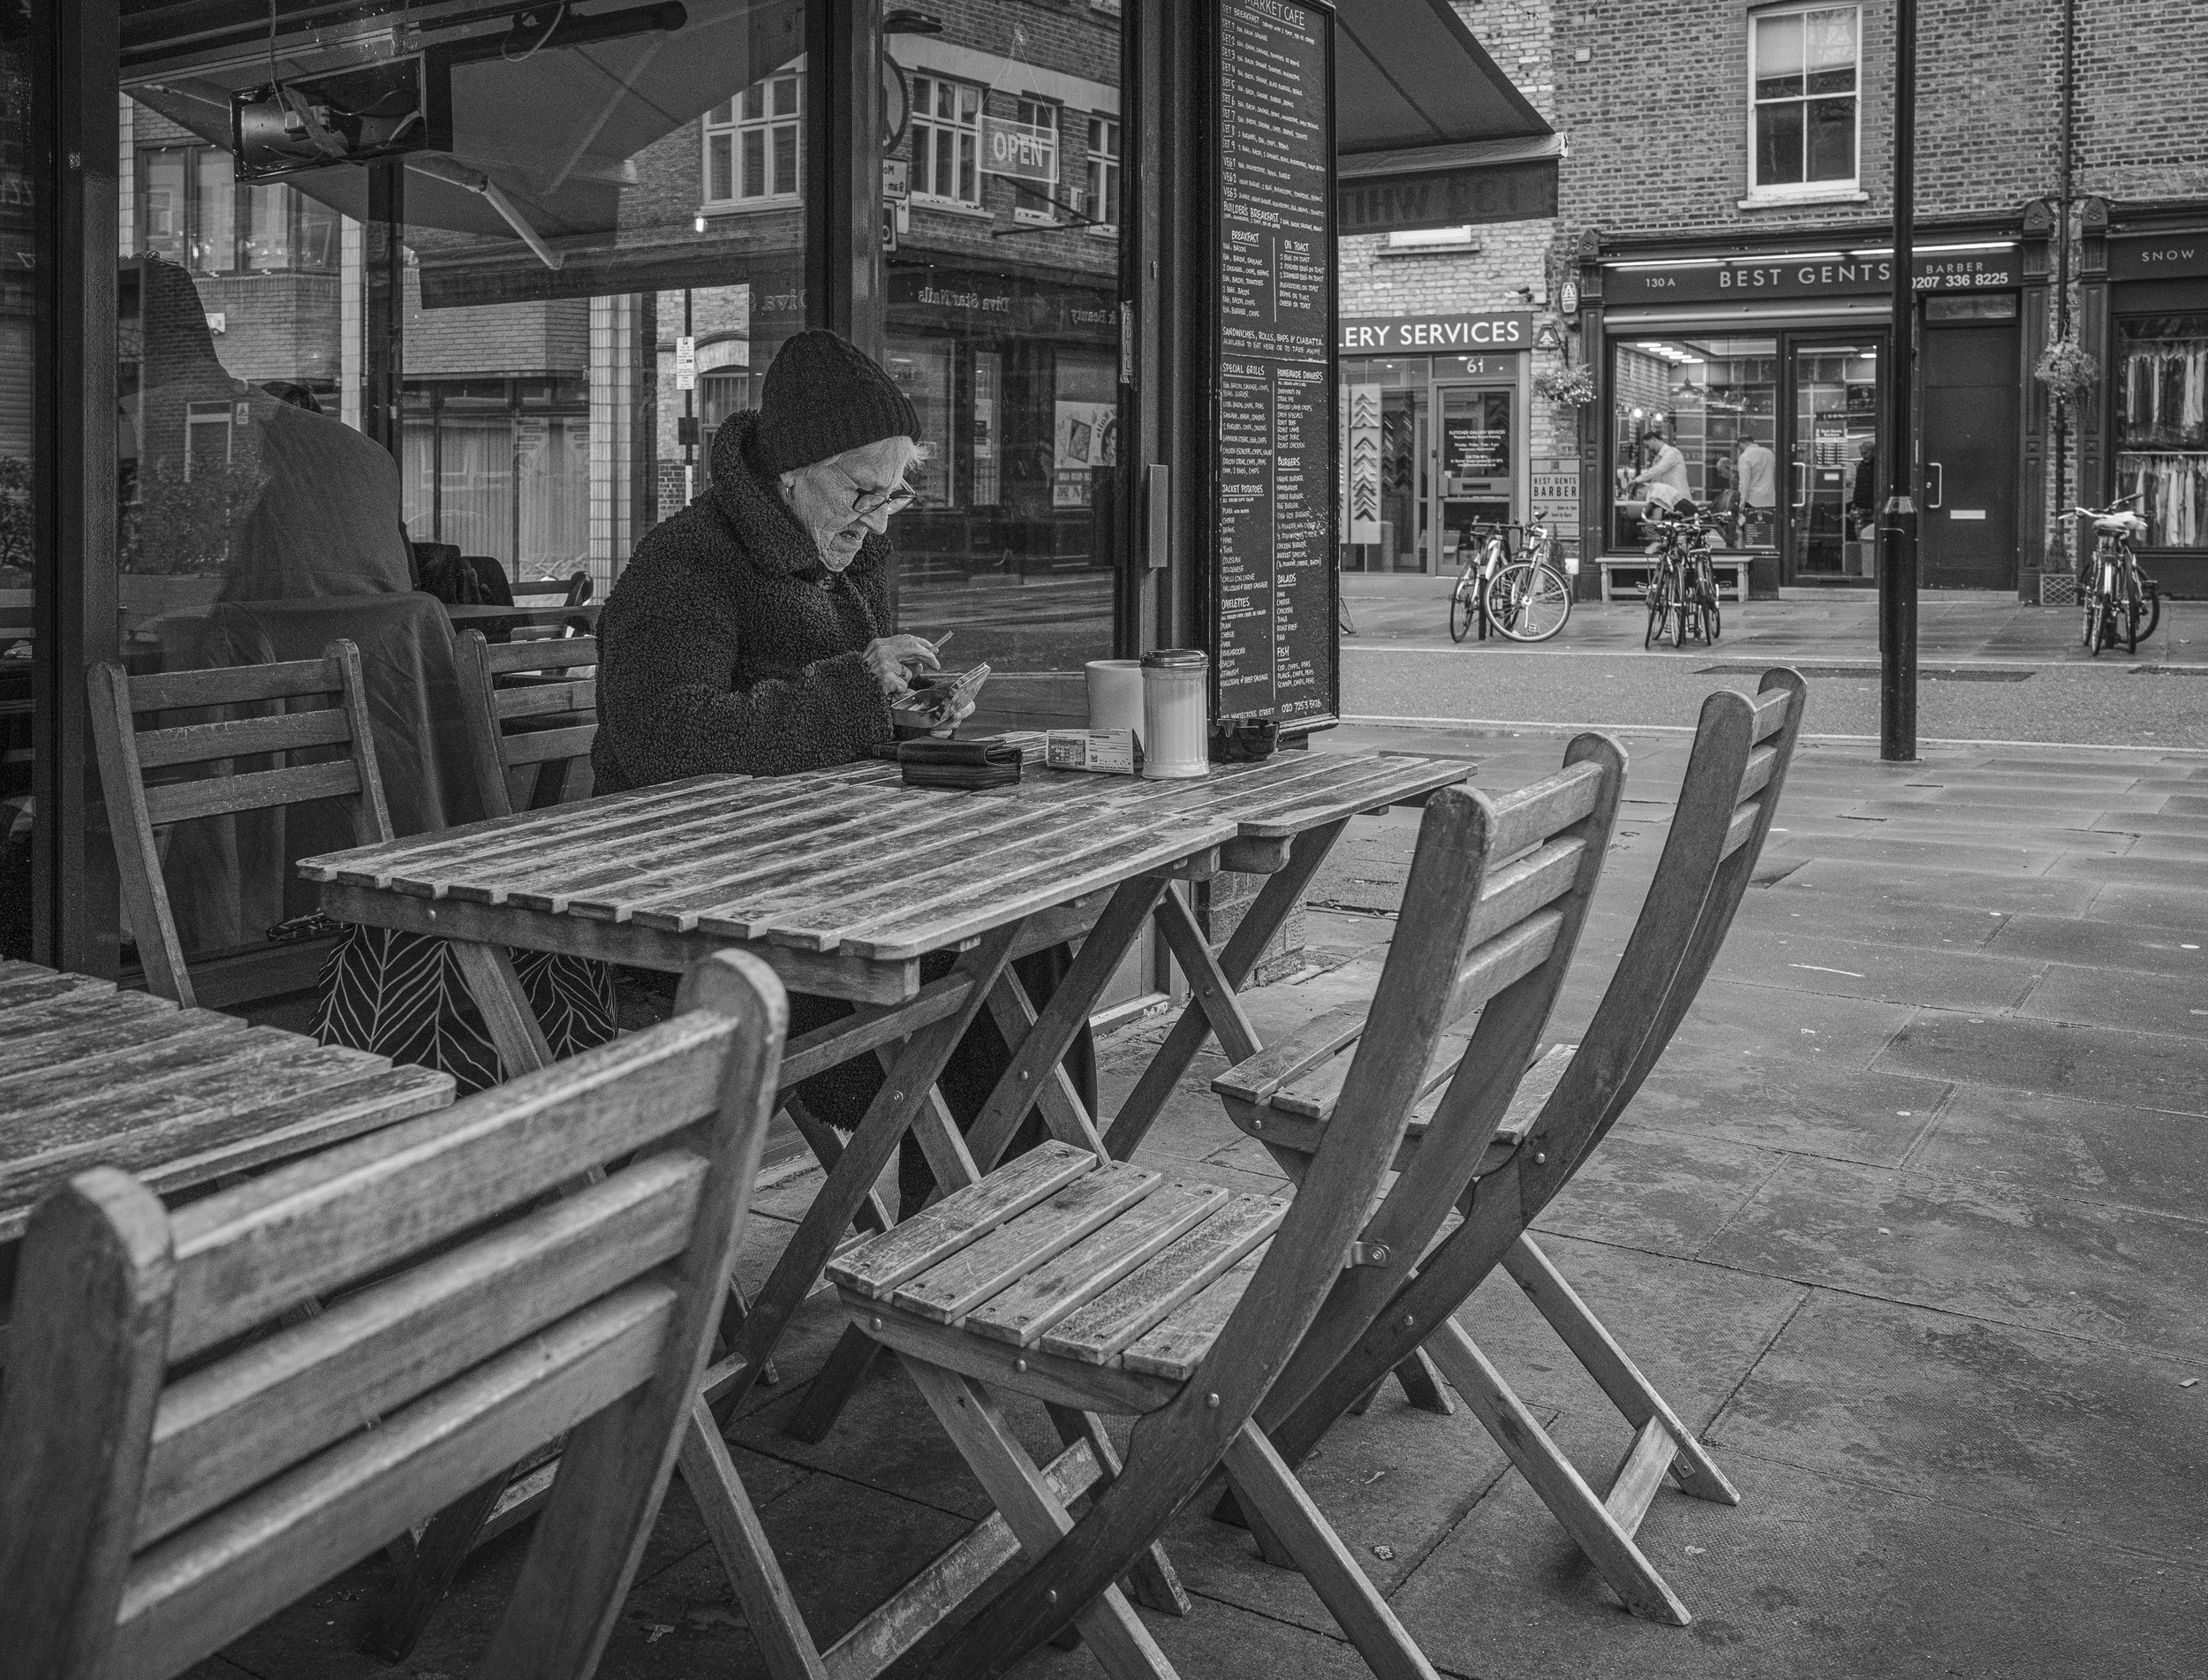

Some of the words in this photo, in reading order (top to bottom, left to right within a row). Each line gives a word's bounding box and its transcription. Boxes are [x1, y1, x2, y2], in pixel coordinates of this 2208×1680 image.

[1222, 4, 1231, 14] SET
[1234, 8, 1259, 23] BREAKFAST
[1284, 6, 1304, 26] CAFE
[1222, 19, 1231, 28] SET
[1222, 32, 1231, 43] SET
[1222, 46, 1231, 57] SET
[1222, 61, 1231, 72] SET
[1222, 77, 1231, 87] SET
[994, 132, 1042, 167] OPEN
[1251, 208, 1279, 223] BREAKFAST
[1232, 231, 1259, 243] BREAKFAST
[1294, 241, 1309, 252] TOAST
[2142, 249, 2195, 262] SNOW
[1247, 257, 1262, 266] SAUSAGE
[1926, 262, 1983, 274] BARBER
[1645, 278, 1665, 287] 130
[1667, 278, 1675, 287] A
[1720, 269, 1781, 288] BEST
[1798, 263, 1890, 284] GENTS
[1946, 275, 1970, 287] 336
[1975, 272, 2008, 285] 8225
[1277, 334, 1289, 343] BAPS
[1339, 326, 1390, 347] ERY
[1400, 321, 1519, 345] SERVICES
[1223, 363, 1244, 374] SPECIAL
[1246, 365, 1265, 375] GRILLS
[1467, 358, 1484, 374] 61
[1277, 368, 1301, 379] HOMEMADE
[1304, 371, 1323, 381] DINNERS
[1278, 457, 1300, 466] BURGERS
[1241, 484, 1263, 493] POTATOES
[1534, 487, 1577, 496] BARBER
[1277, 573, 1297, 584] SALADS
[1221, 597, 1250, 609] OMELETTES
[1221, 647, 1245, 656] MUSHROOM
[1277, 646, 1289, 657] FISH
[1231, 710, 1257, 719] WHITECROSS
[1259, 708, 1274, 716] STREET
[1282, 703, 1292, 713] 020
